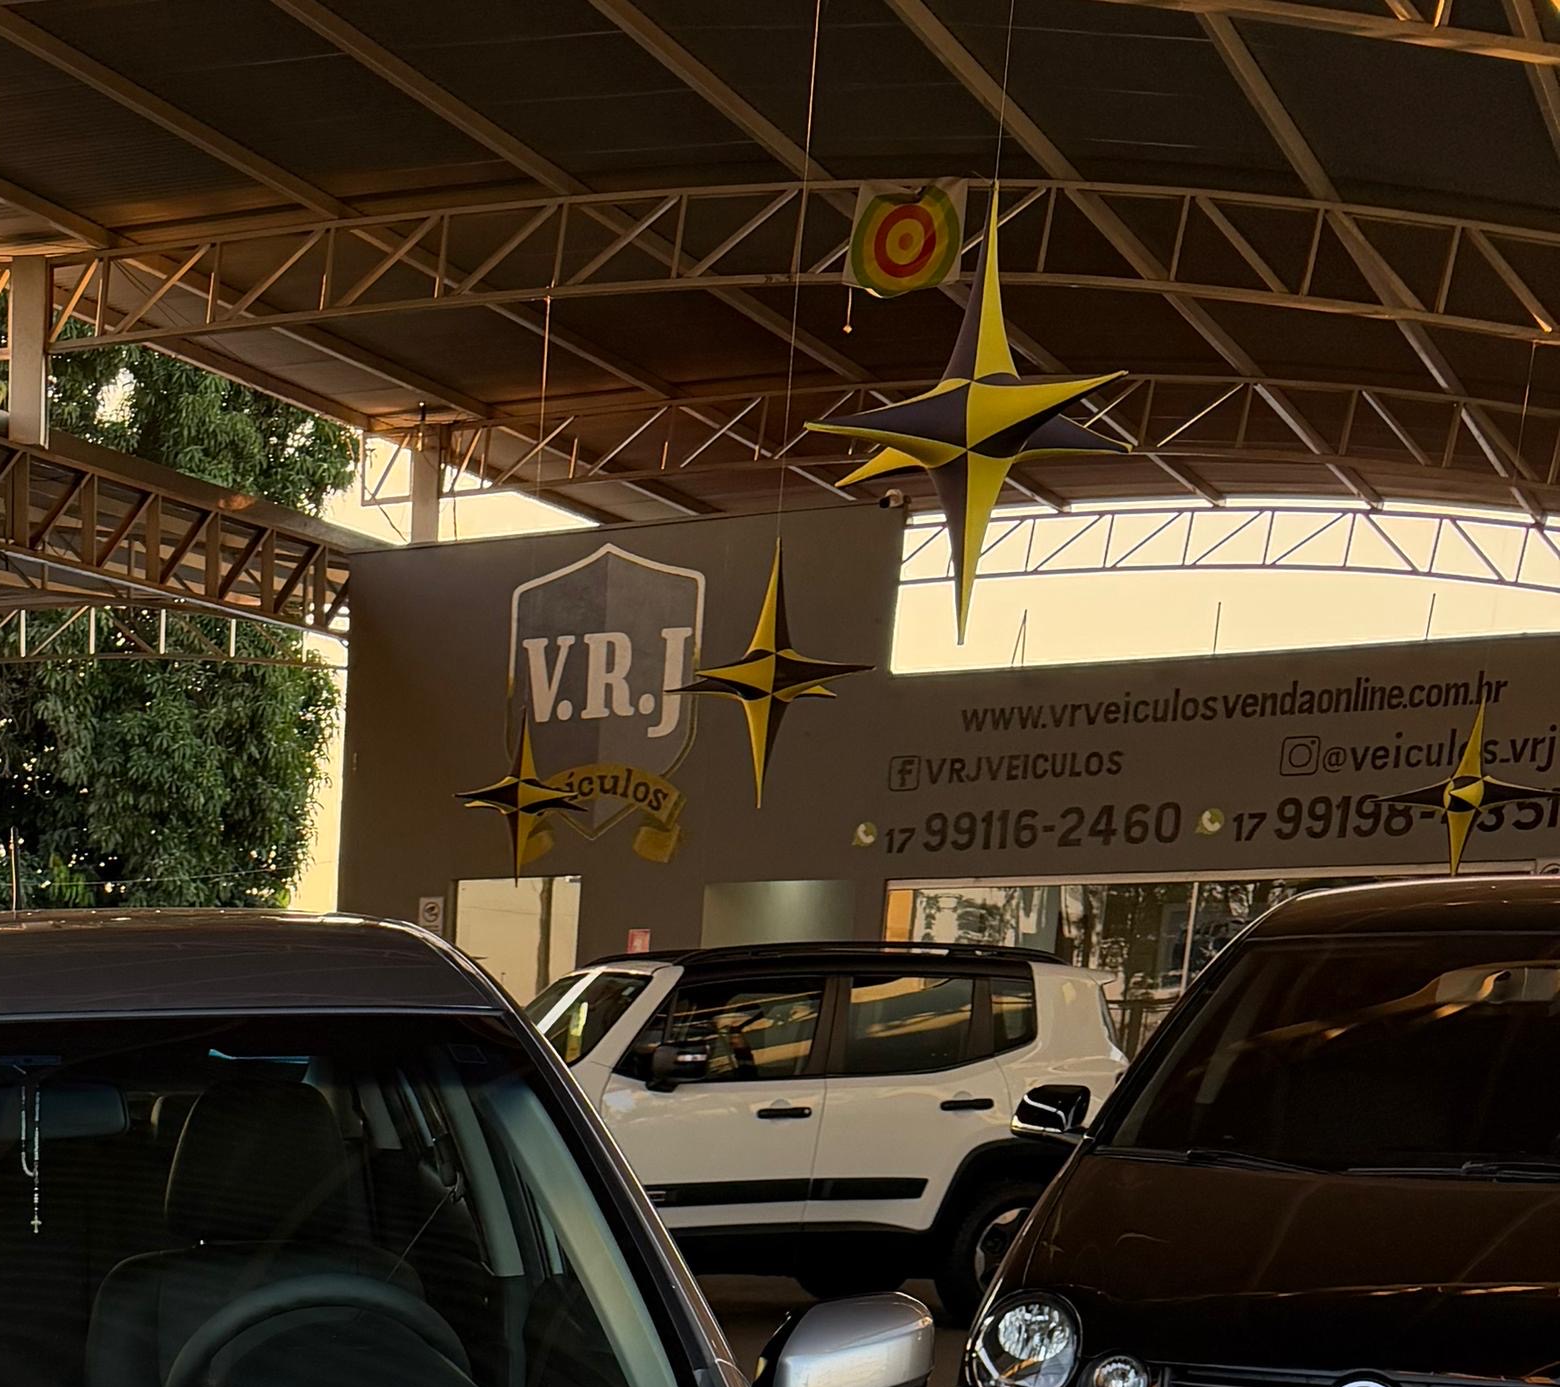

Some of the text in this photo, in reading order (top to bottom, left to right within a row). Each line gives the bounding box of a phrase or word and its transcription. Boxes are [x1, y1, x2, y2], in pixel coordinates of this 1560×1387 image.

[522, 627, 694, 738] V.R.J
[547, 767, 670, 812] ículos
[926, 750, 1125, 786] VRJVEICULOS
[885, 801, 1182, 854] 17 99116-2460
[1232, 787, 1560, 843] 17 99198-351
